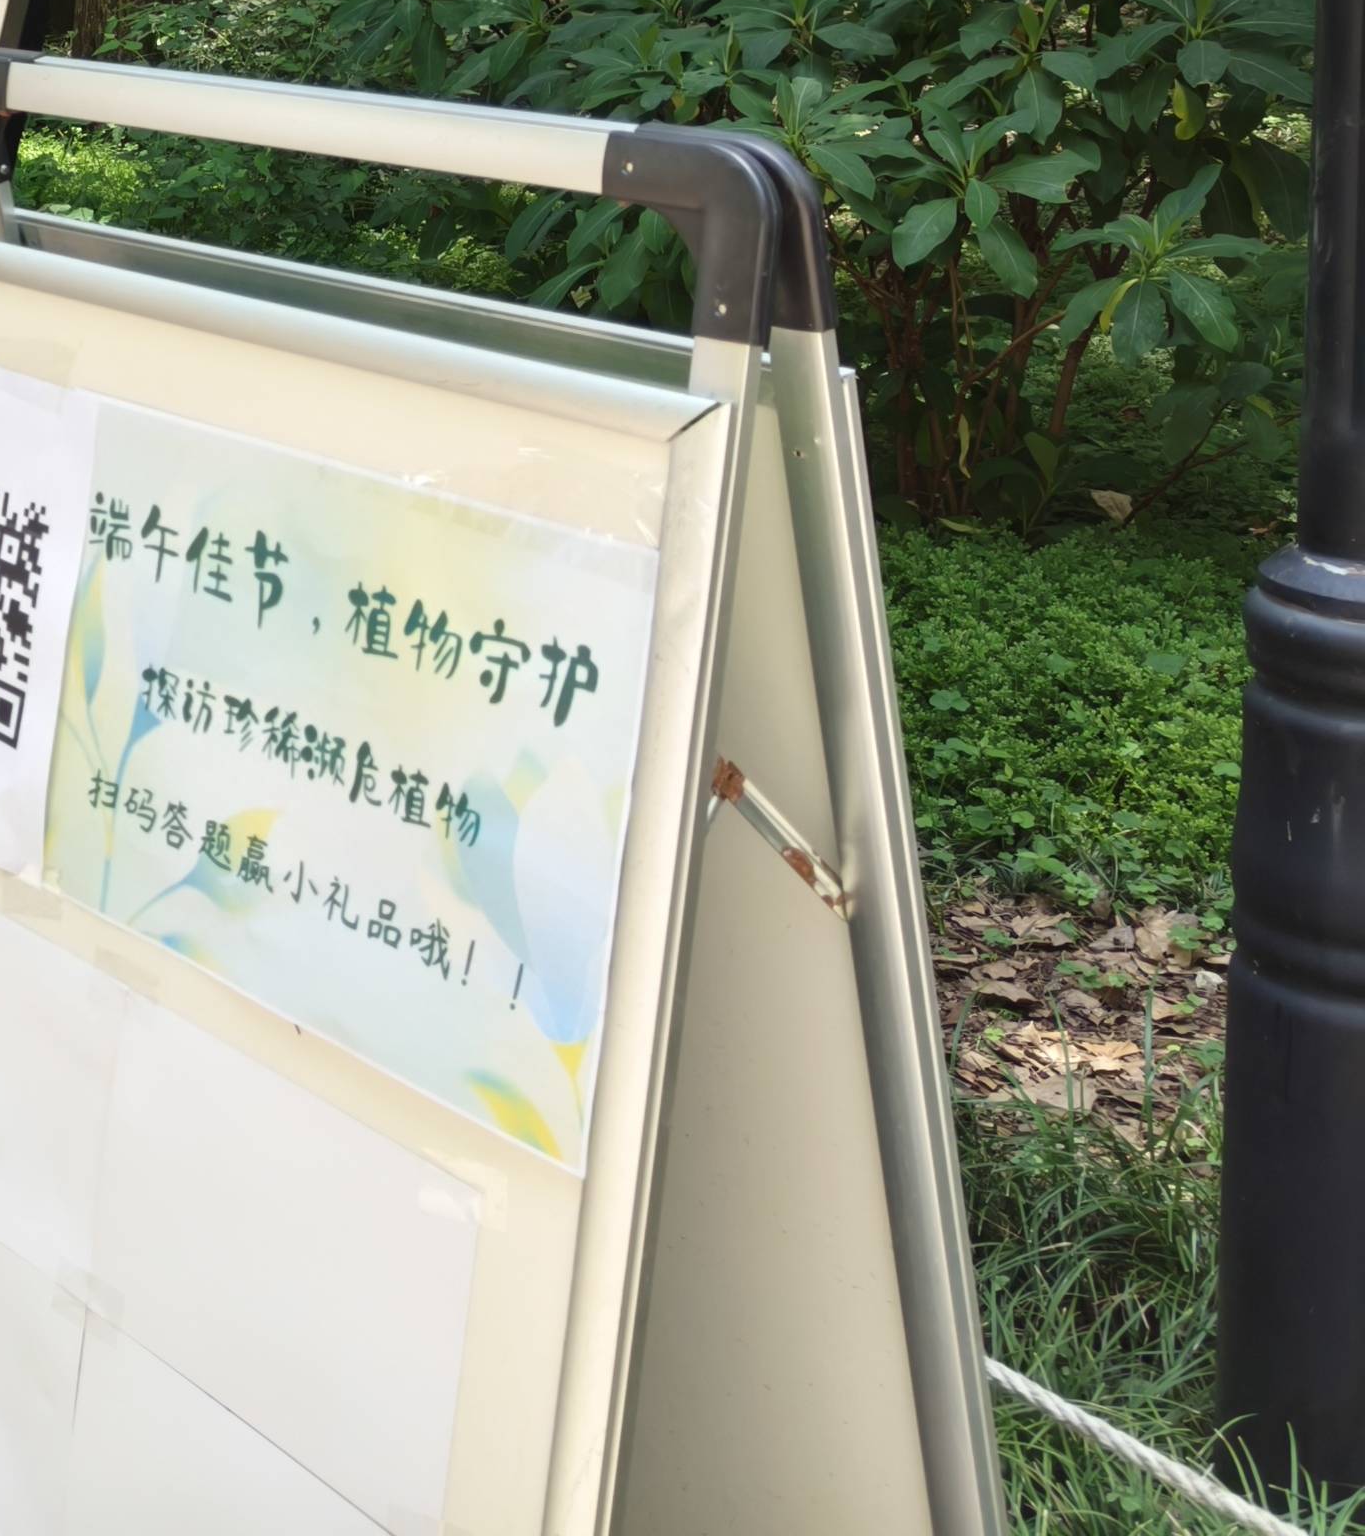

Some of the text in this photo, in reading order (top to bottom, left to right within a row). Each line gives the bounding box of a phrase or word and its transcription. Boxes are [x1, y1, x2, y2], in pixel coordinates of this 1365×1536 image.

[89, 491, 599, 727] 端午佳节，植物守护
[142, 665, 480, 847] 探访珍稀濒危植物
